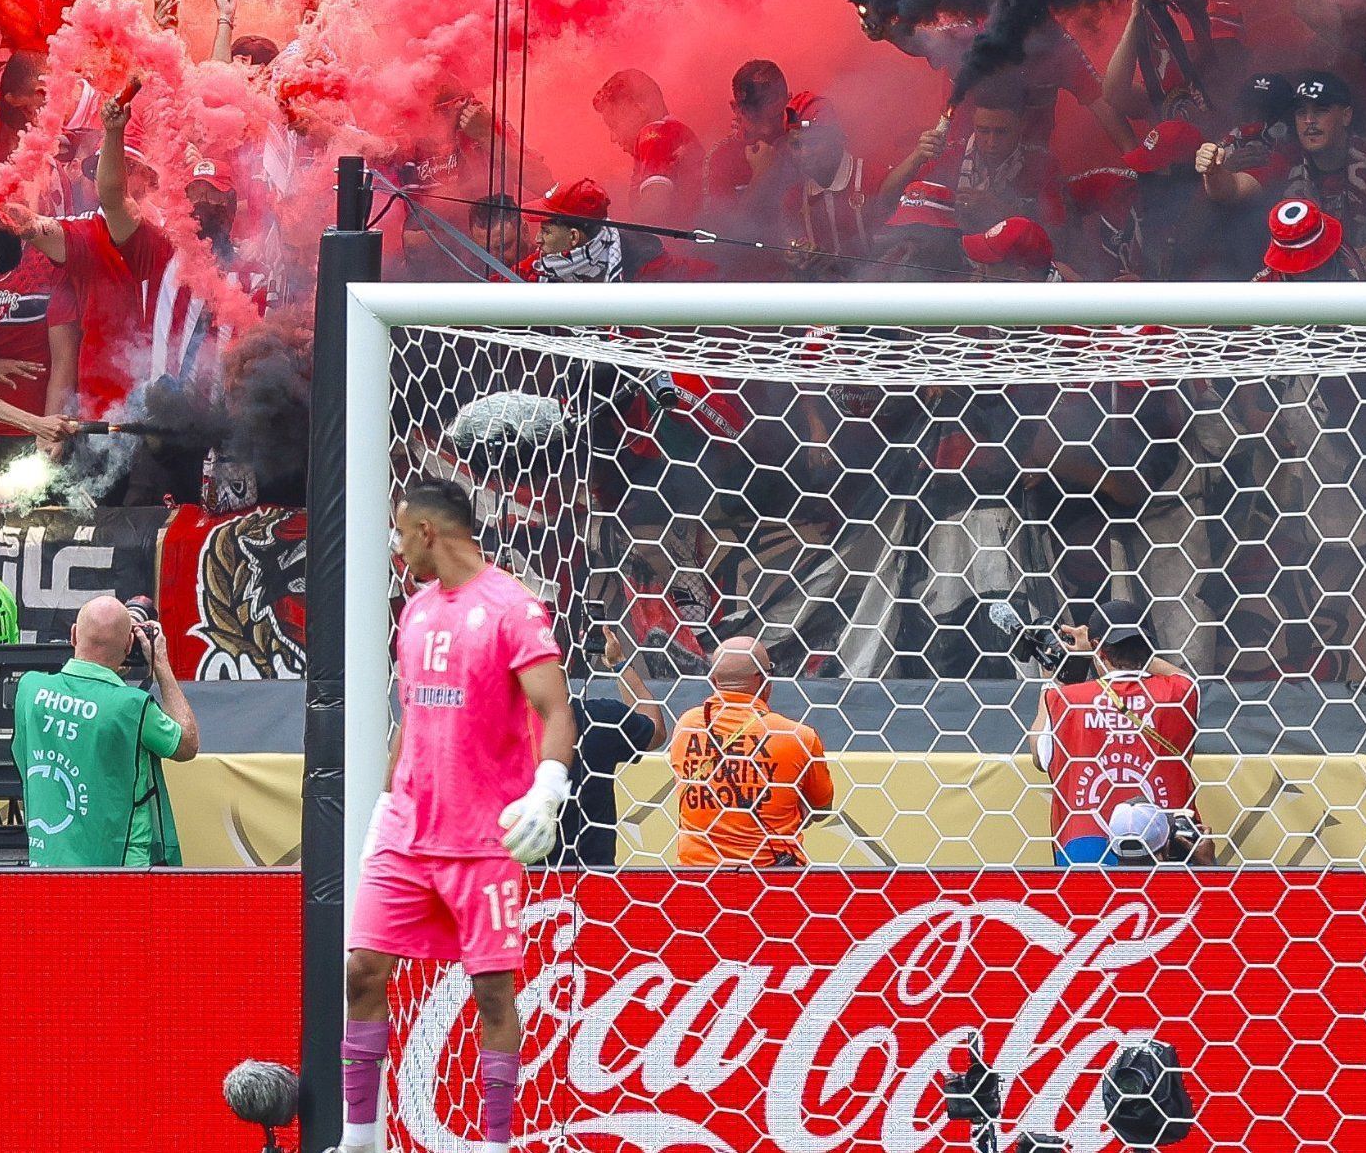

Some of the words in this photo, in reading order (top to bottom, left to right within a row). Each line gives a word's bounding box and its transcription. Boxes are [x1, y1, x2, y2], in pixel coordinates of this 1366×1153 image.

[422, 630, 452, 673] 12
[34, 688, 98, 720] PHOTO
[1093, 695, 1146, 711] CLUB
[43, 715, 79, 741] 715
[1085, 713, 1155, 728] MEDIA
[685, 733, 771, 758] APEX
[33, 749, 80, 777] WORLD
[78, 783, 88, 816] CUP
[1076, 766, 1094, 806] CLUB
[1099, 753, 1151, 773] WORLD
[1155, 776, 1168, 808] CUP
[686, 786, 772, 810] GROUP
[482, 878, 519, 931] 12
[397, 900, 1200, 1153] Coca-Cola
